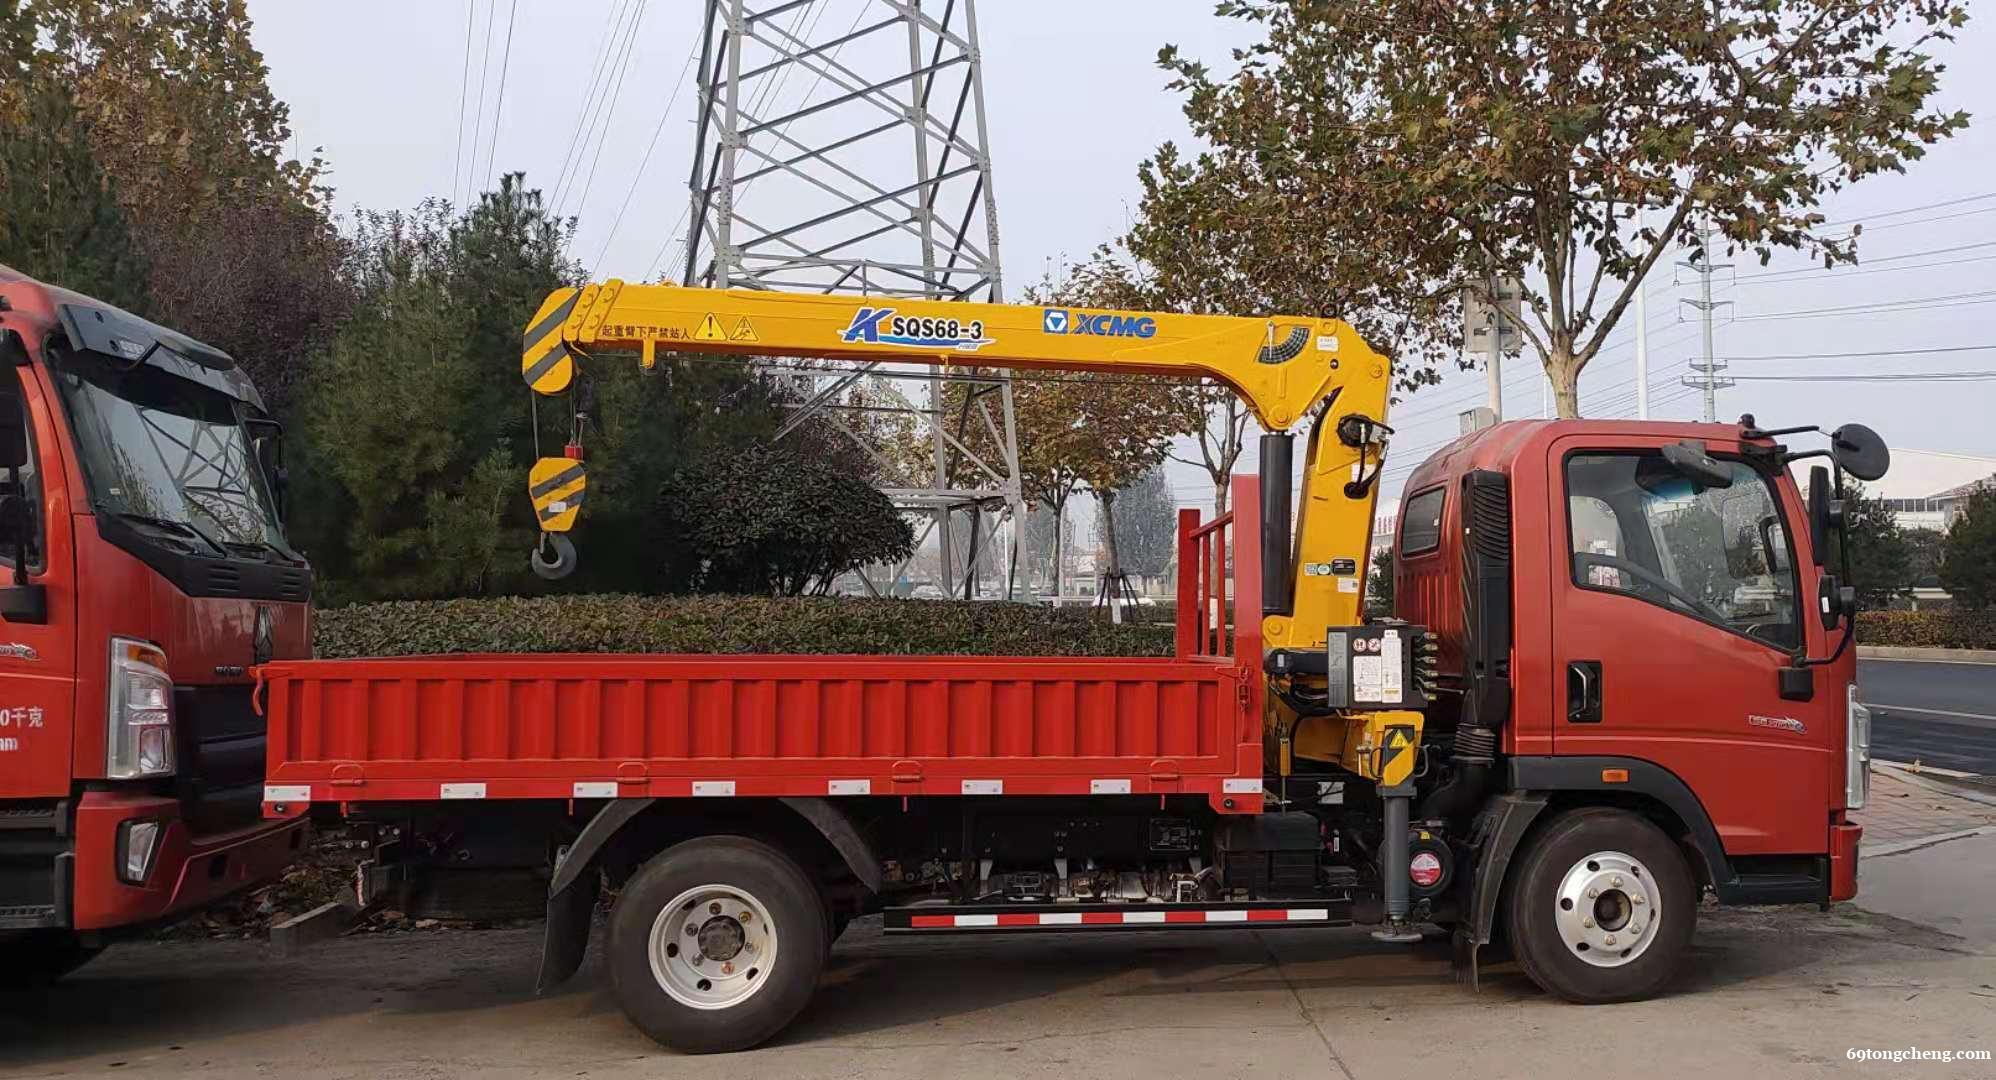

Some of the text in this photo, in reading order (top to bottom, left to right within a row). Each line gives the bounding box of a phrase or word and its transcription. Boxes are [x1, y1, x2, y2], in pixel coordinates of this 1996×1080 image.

[602, 324, 690, 339] 起重臂下严禁站人
[892, 317, 982, 340] SQS68-3
[1071, 313, 1157, 338] XCMG
